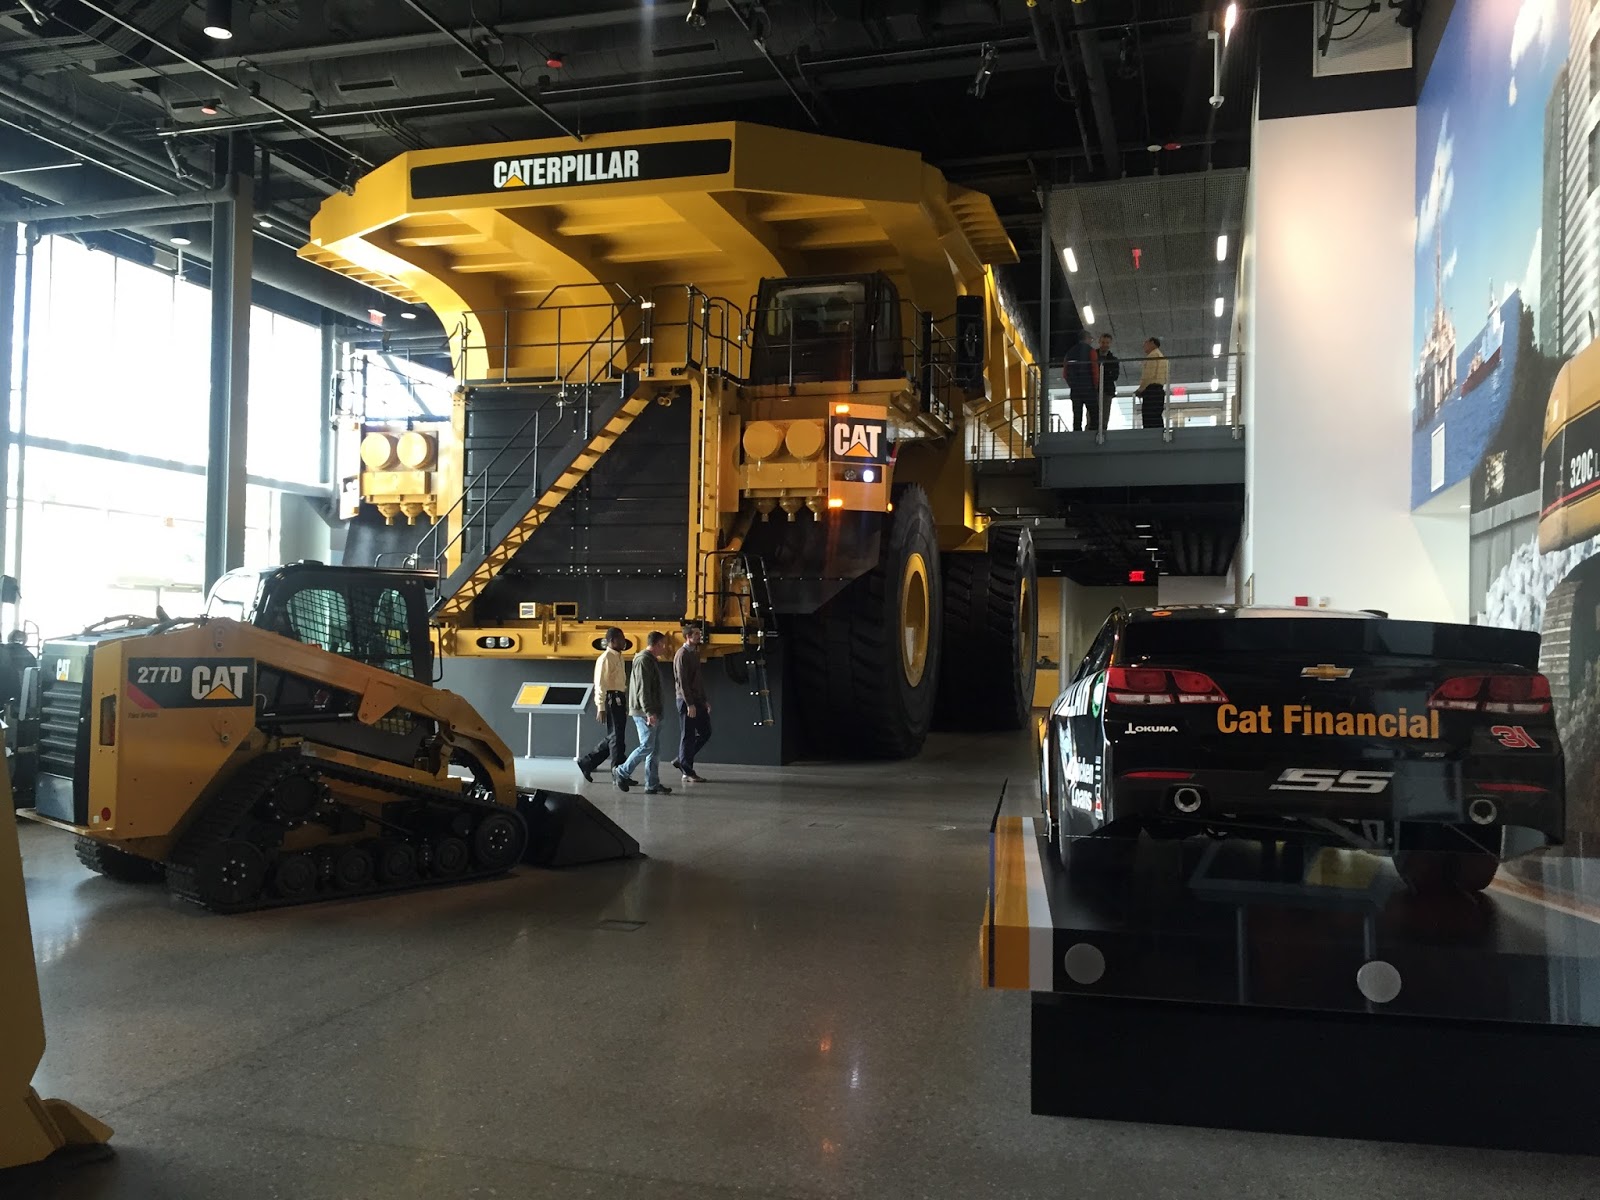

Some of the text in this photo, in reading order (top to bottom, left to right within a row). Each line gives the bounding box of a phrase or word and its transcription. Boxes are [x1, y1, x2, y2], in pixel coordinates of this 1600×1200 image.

[493, 149, 640, 189] CATERPILLAR
[833, 422, 882, 458] CAT
[1569, 447, 1594, 489] 320C
[137, 665, 248, 700] 277D CAT
[1216, 703, 1440, 740] Cat Financial
[1490, 725, 1541, 749] 31
[1071, 782, 1093, 812] Loans
[1268, 767, 1396, 794] SS
